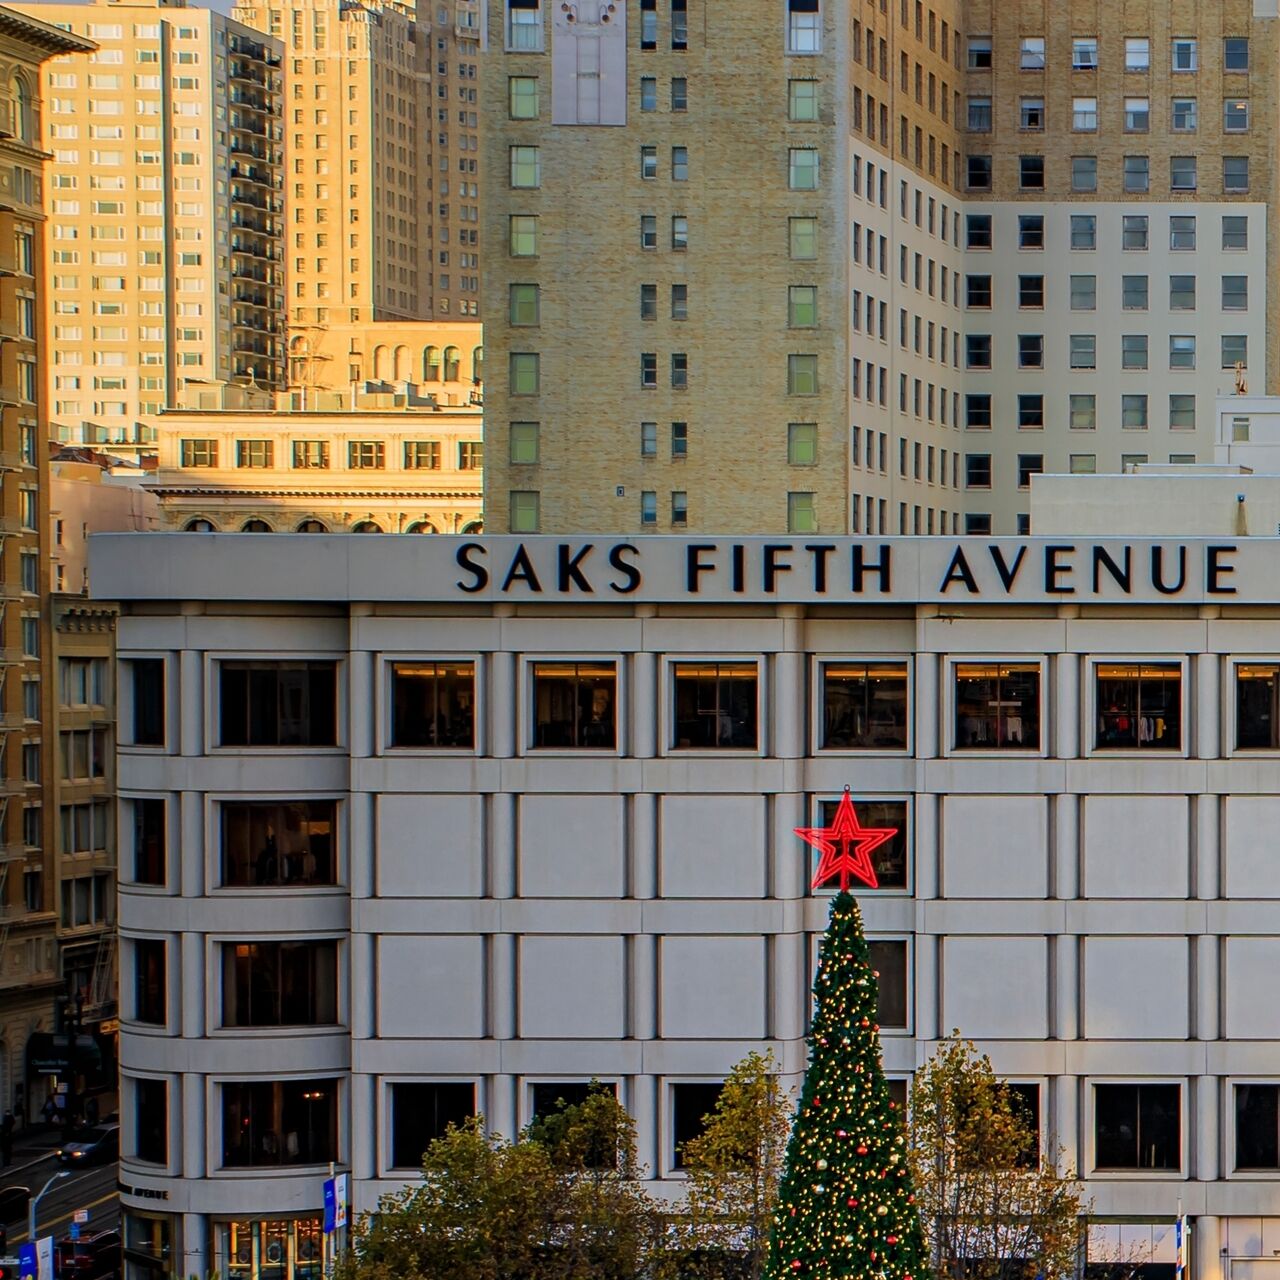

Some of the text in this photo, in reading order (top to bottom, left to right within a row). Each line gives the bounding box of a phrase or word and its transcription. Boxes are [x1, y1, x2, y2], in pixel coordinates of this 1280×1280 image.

[455, 543, 1238, 594] SAKS FIFTH AVENUE
